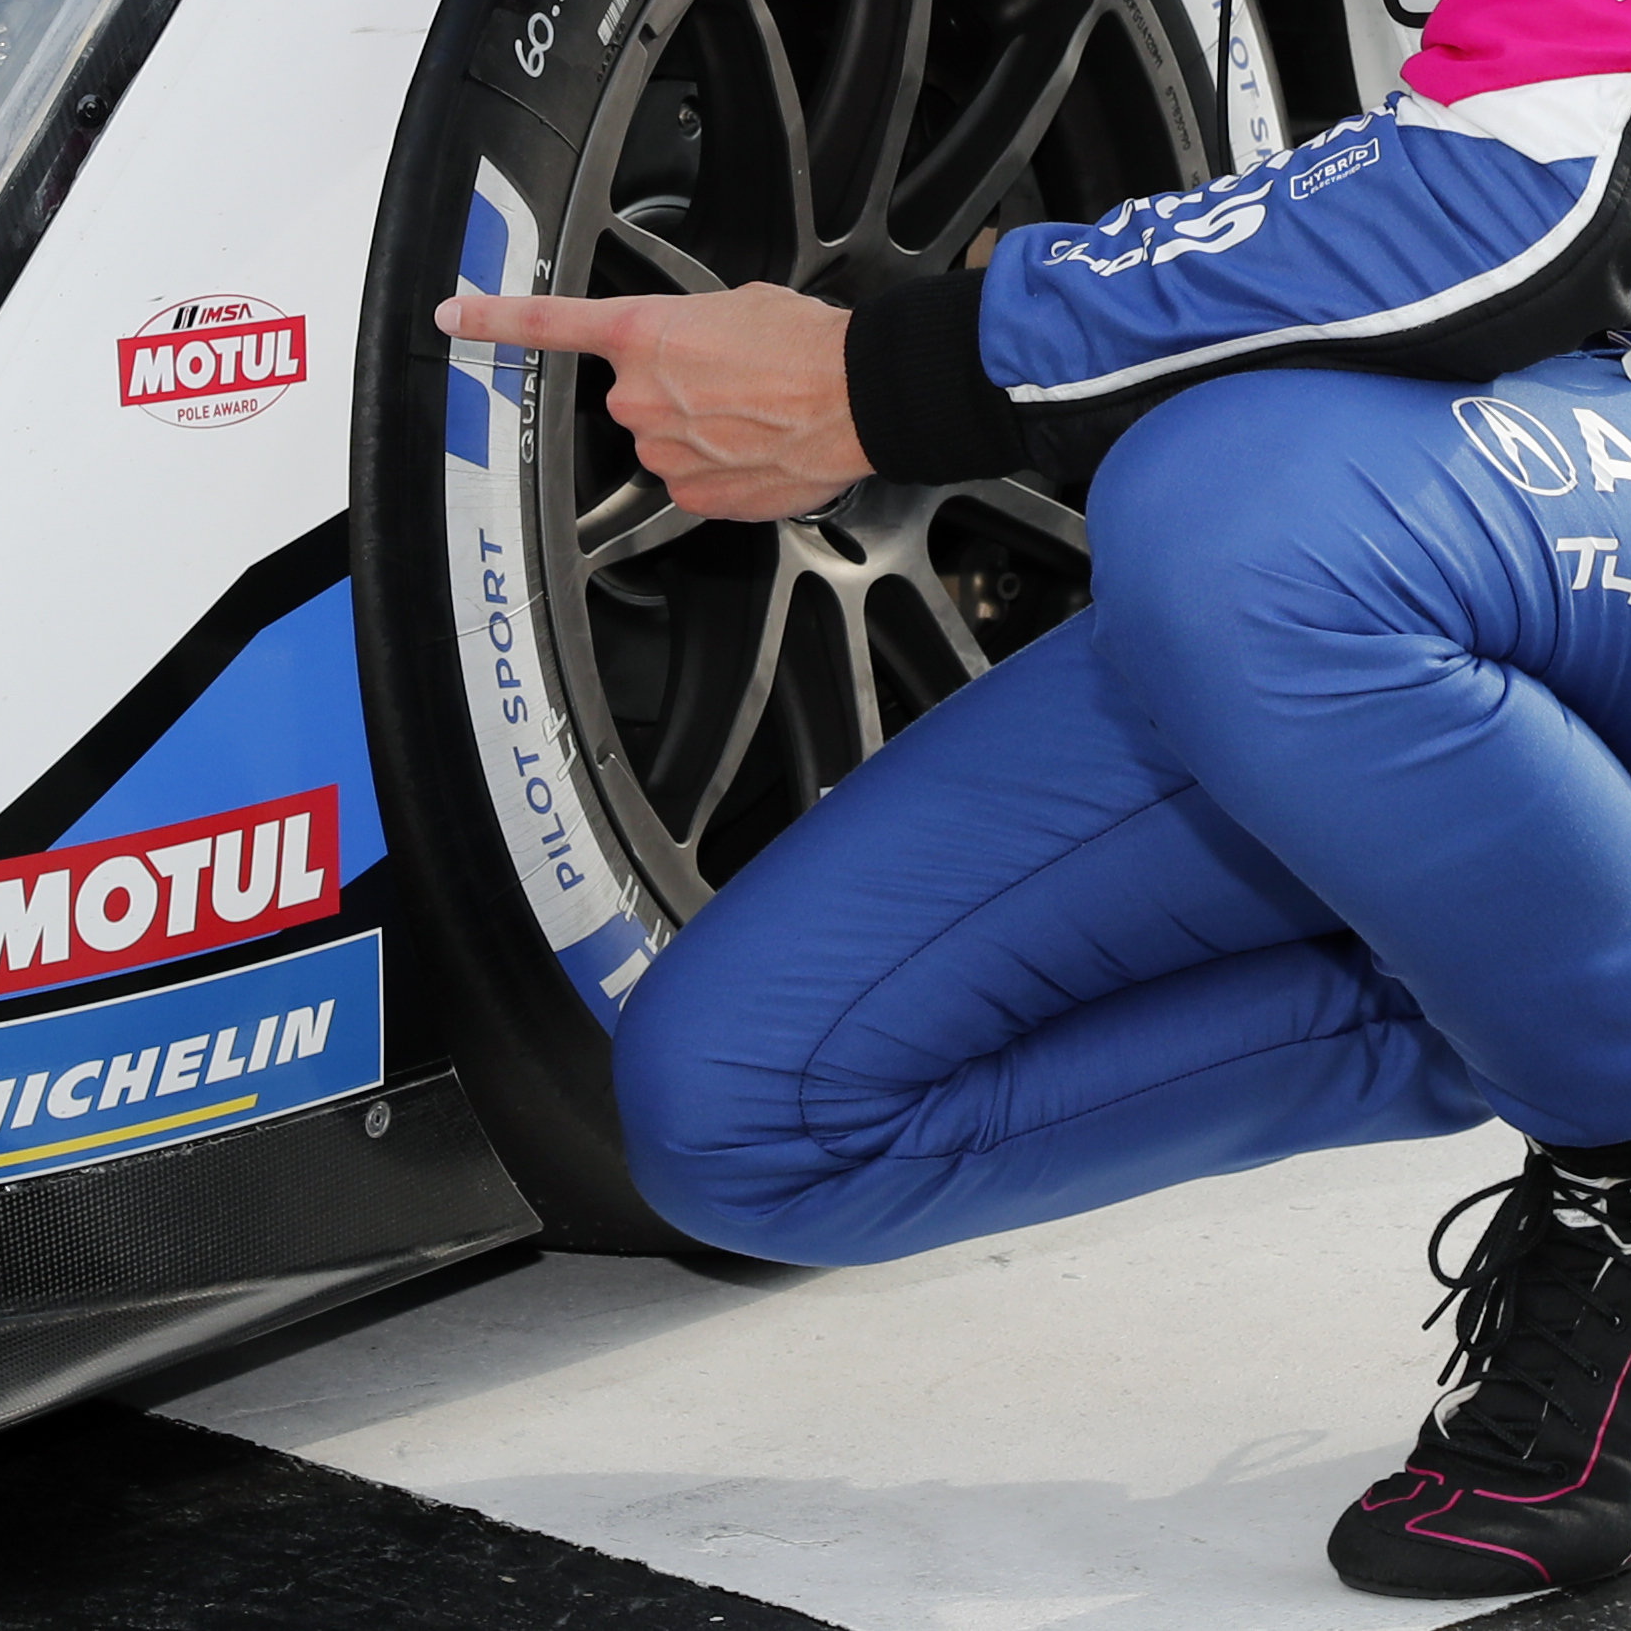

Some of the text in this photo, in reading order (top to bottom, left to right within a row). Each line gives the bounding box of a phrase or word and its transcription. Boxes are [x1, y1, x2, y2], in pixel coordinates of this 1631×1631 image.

[1301, 147, 1370, 193] HYBRID
[199, 303, 253, 326] IMSA
[127, 328, 300, 398] MOTUL
[177, 397, 258, 423] POLE AWARD
[479, 527, 585, 892] PILOT SPORT
